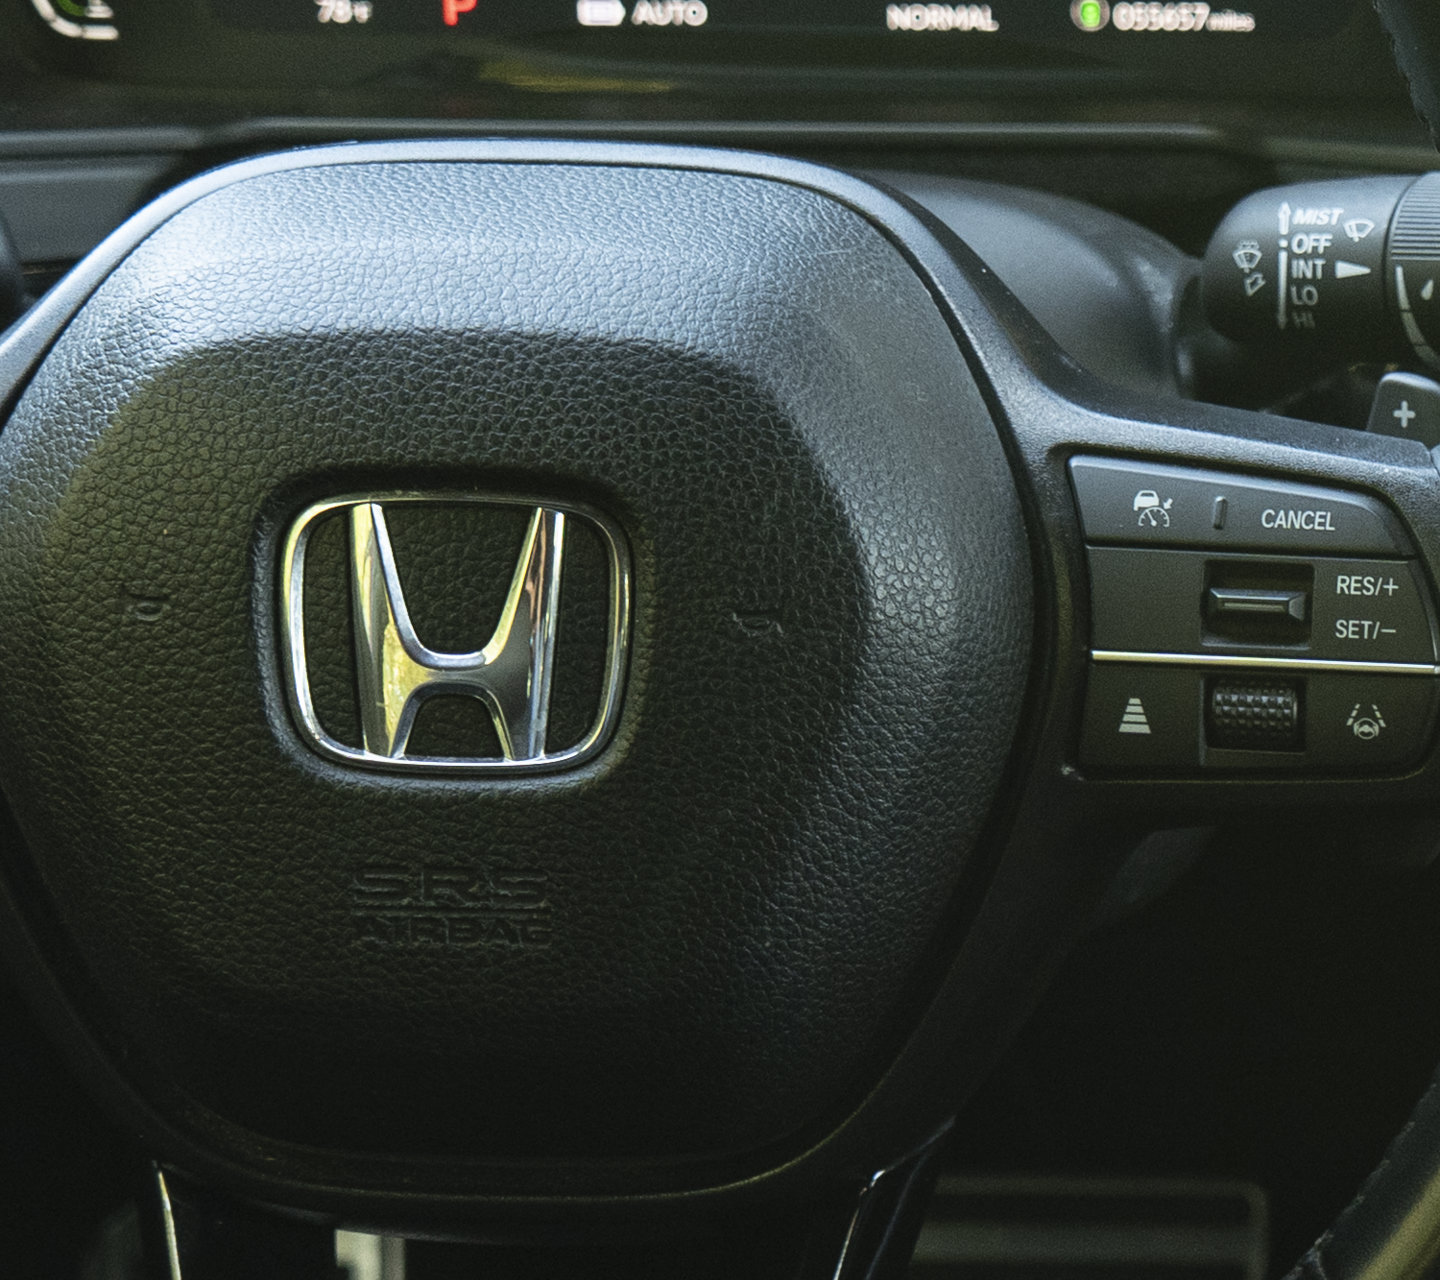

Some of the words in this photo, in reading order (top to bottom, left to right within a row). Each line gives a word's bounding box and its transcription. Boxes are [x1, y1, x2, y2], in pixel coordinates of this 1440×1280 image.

[886, 3, 999, 32] NORMAL
[1291, 208, 1344, 227] MIST
[1290, 233, 1334, 256] OFF
[1290, 260, 1326, 280] INT
[1290, 285, 1319, 306] LO
[1260, 508, 1335, 531] CANCEL
[1336, 574, 1399, 596] RES/+
